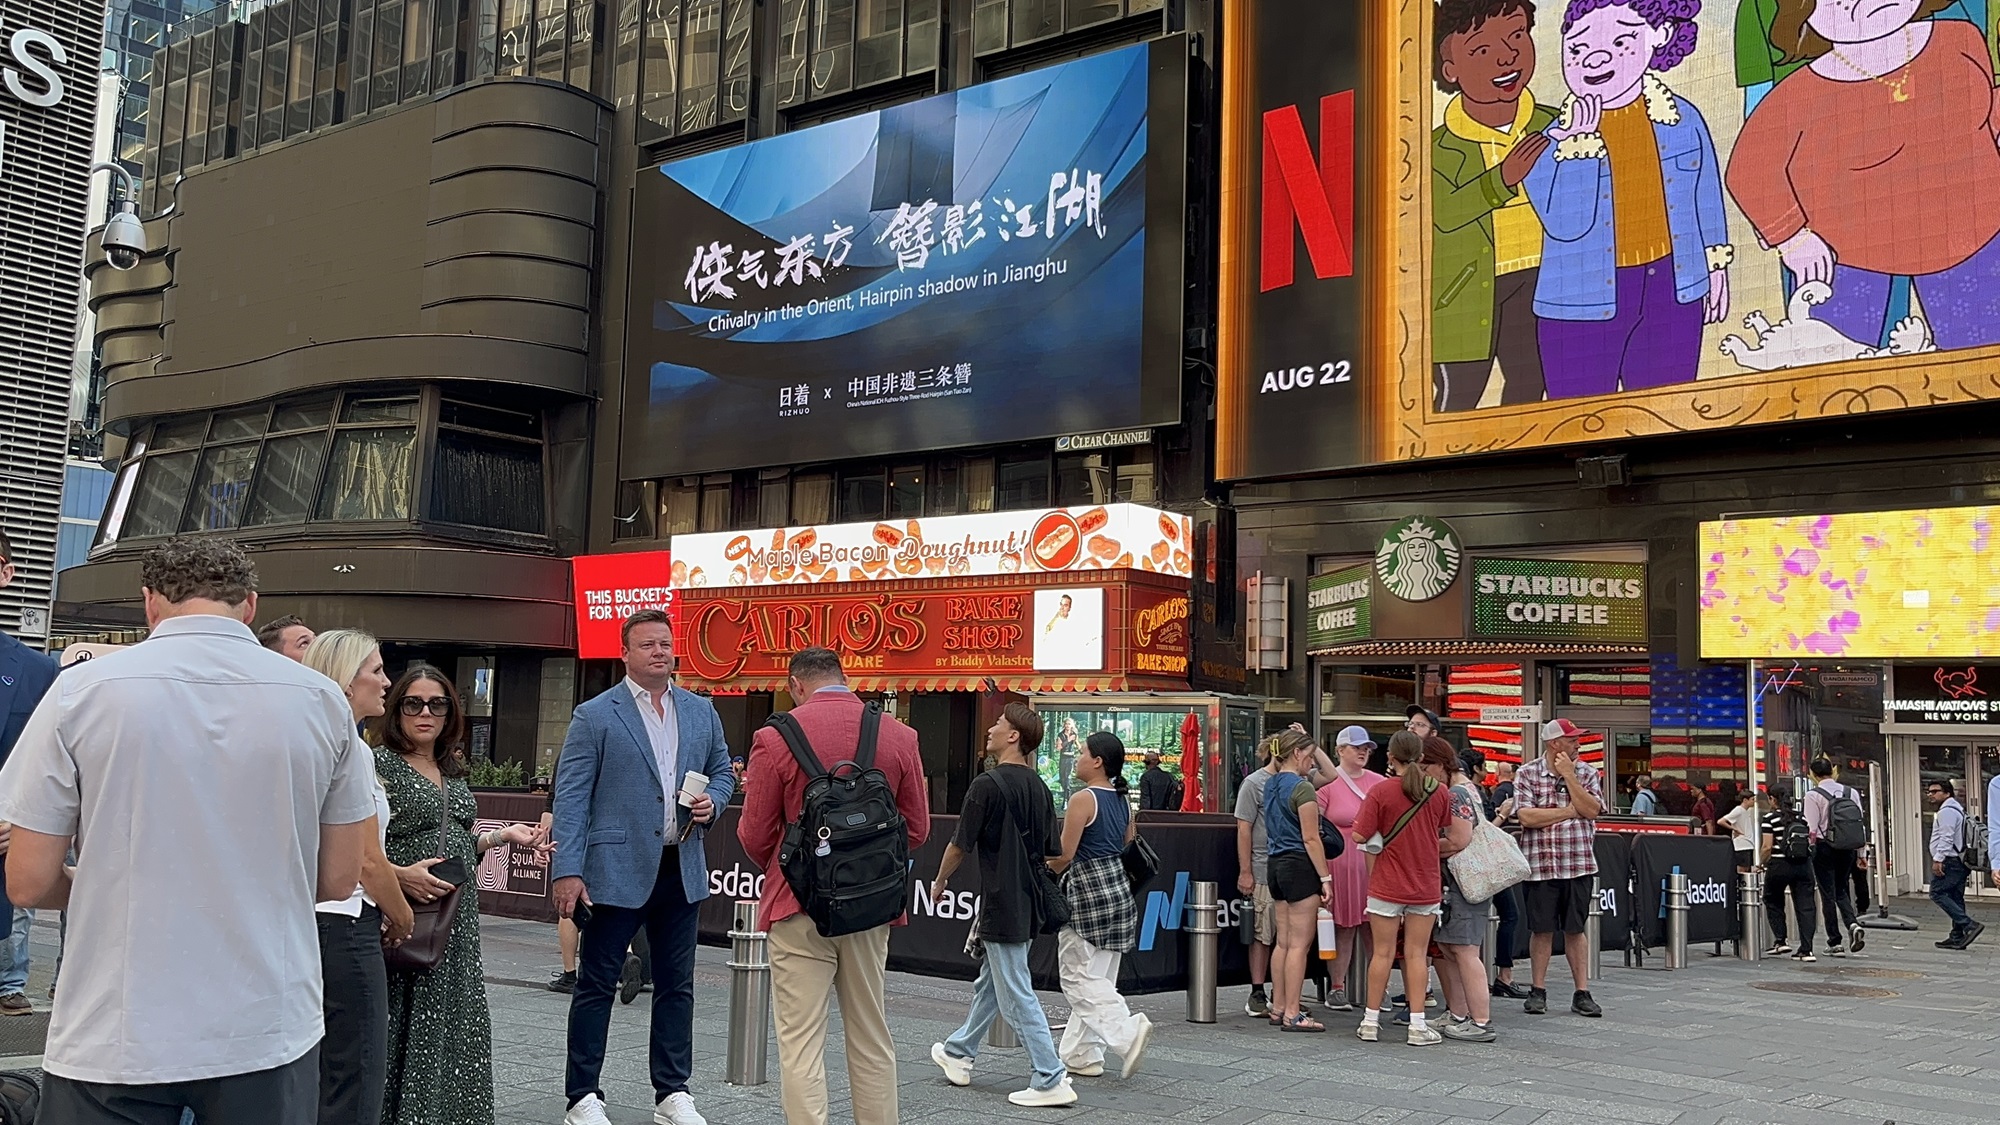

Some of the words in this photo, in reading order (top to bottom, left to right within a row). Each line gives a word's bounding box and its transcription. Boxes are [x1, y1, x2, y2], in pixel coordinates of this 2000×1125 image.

[1, 26, 67, 107] S
[708, 309, 761, 332] Chivalry
[764, 307, 777, 323] in
[781, 303, 803, 320] the
[807, 295, 855, 316] Orient,
[860, 283, 913, 308] Hairpin
[918, 274, 978, 298] shadow
[983, 269, 997, 286] in
[1002, 258, 1067, 284] Jianghu
[1260, 366, 1315, 394] AUG
[1319, 360, 1351, 385] 22
[779, 407, 811, 417] RIZHUO
[728, 539, 748, 557] NEW
[748, 546, 812, 572] Maple
[819, 542, 889, 564] Bacon
[898, 529, 1028, 566] Doughnut!
[585, 589, 612, 605] THIS
[614, 587, 673, 604] BUCKET'S
[1308, 578, 1369, 609] STARBUCKS
[1477, 574, 1641, 599] STARBUCKS
[589, 605, 613, 620] FOR
[945, 596, 1023, 621] BAKE
[1317, 607, 1357, 631] COFFEE
[1506, 601, 1609, 625] COFFEE
[1136, 597, 1188, 647] CARLO'S
[943, 623, 1023, 650] SHOP
[842, 655, 883, 668] UARE
[936, 657, 947, 666] BY
[950, 654, 985, 668] Buddy
[1883, 700, 1935, 710] TAMASHII
[1935, 700, 1987, 711] NATIONS
[1924, 712, 1951, 721] NEW
[1954, 712, 1988, 721] YORK
[511, 852, 536, 867] SQUA
[512, 868, 541, 880] ALLIANCE
[913, 880, 980, 921] Nas
